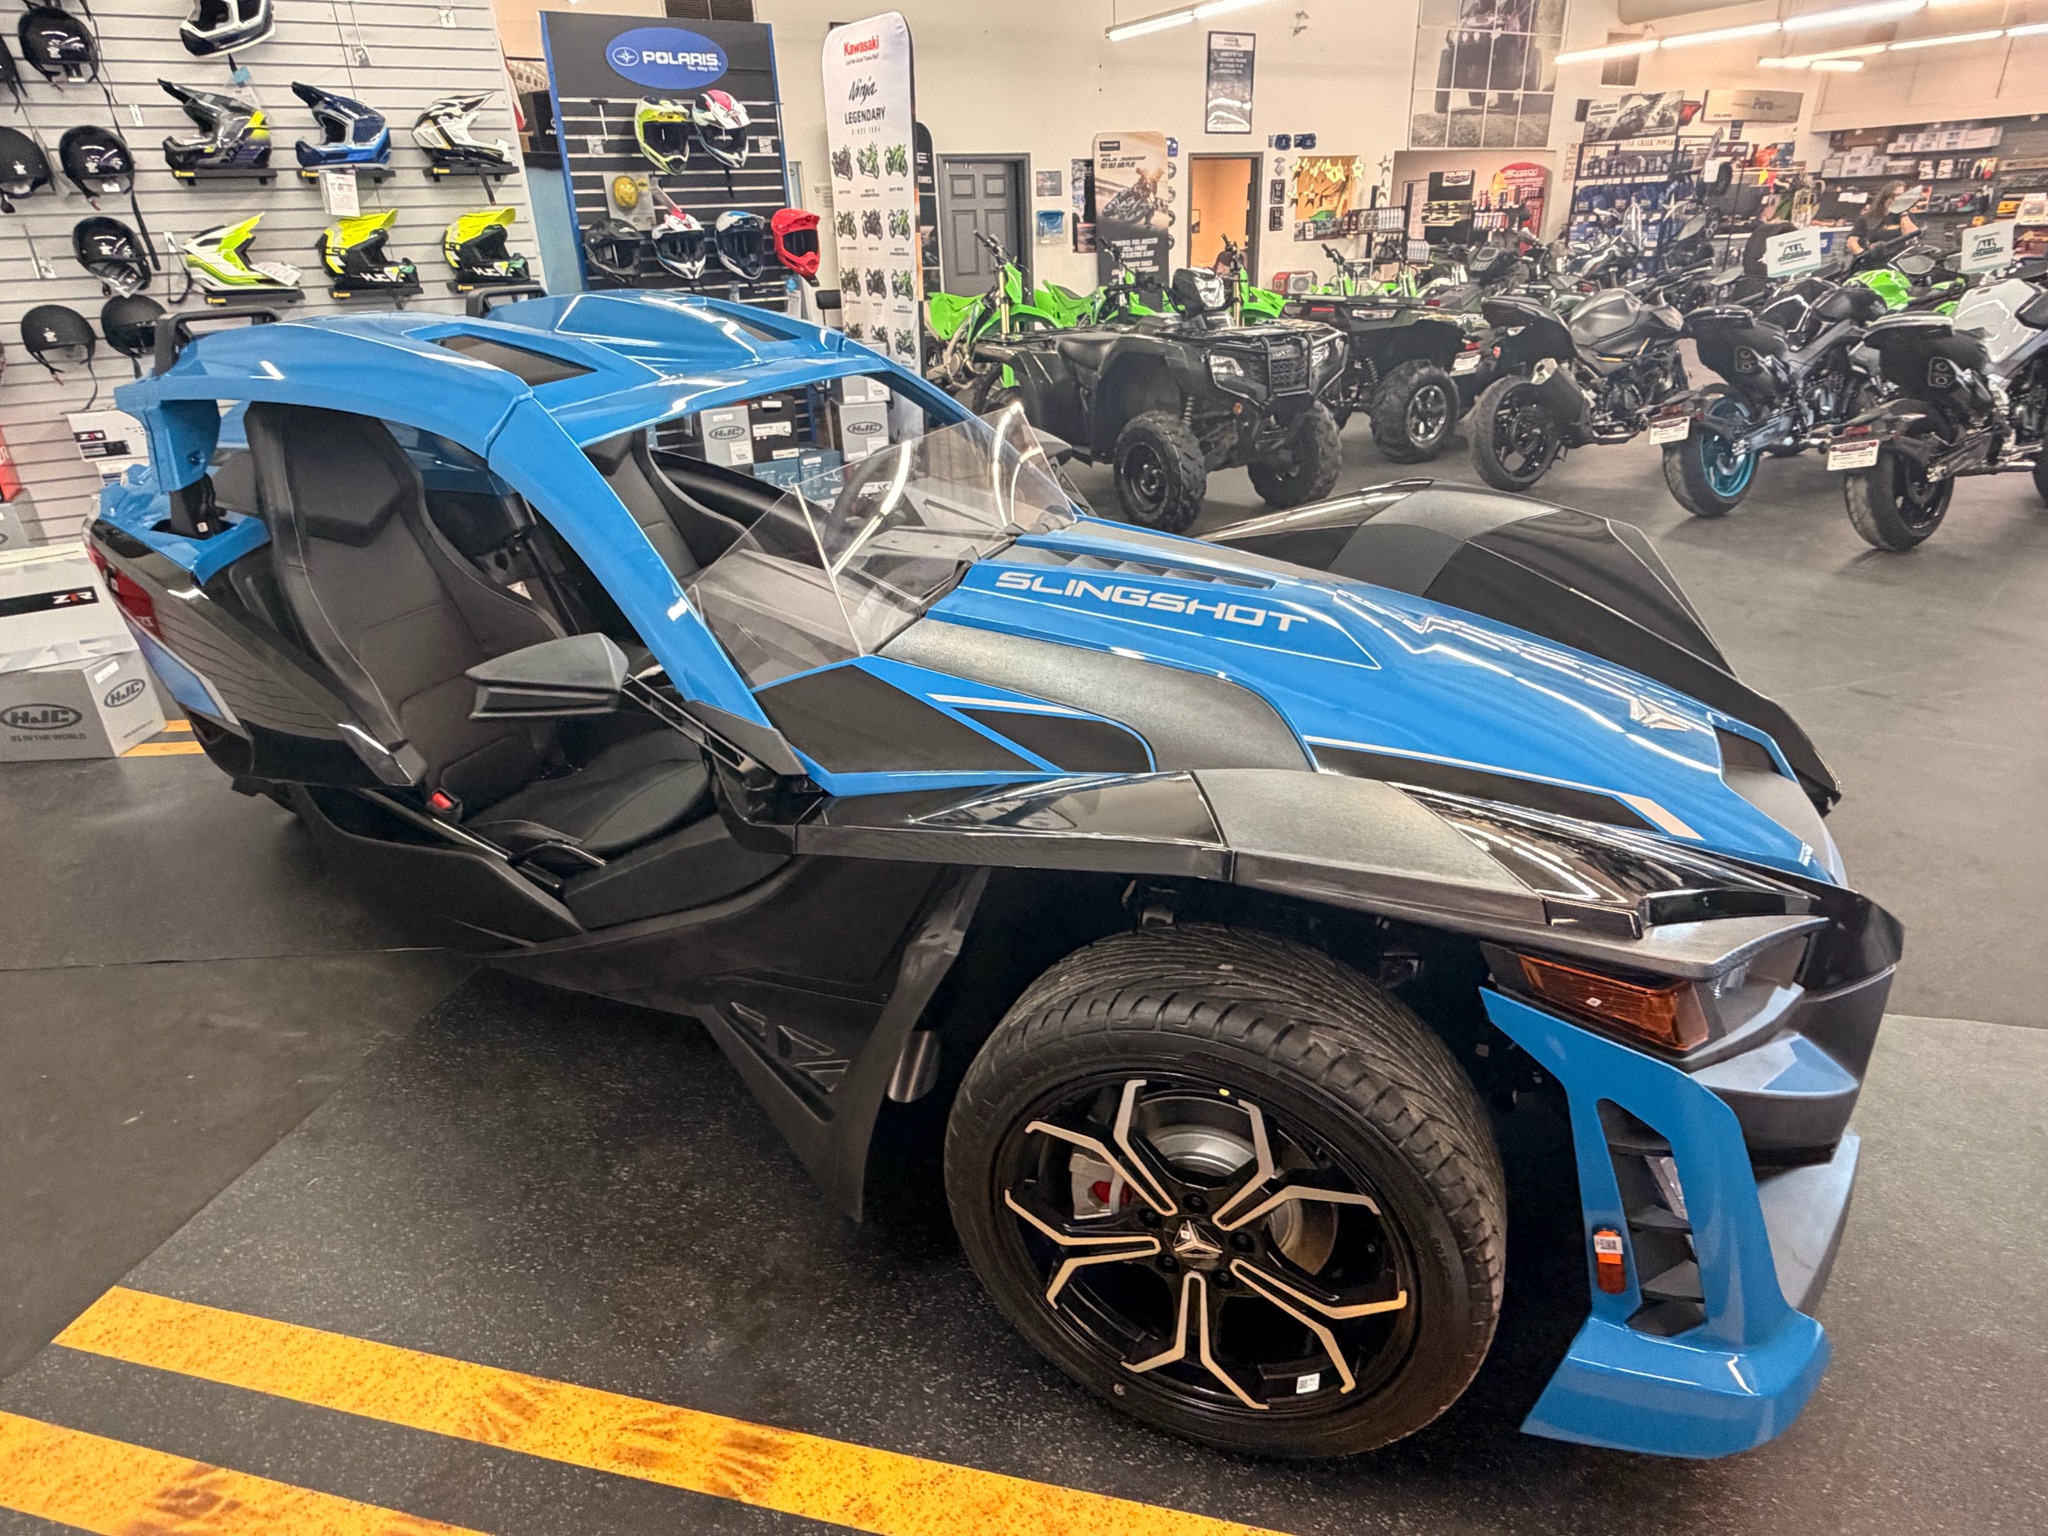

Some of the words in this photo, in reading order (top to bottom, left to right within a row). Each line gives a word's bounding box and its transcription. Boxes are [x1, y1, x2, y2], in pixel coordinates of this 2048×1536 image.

[843, 35, 879, 56] Kawasaki
[642, 51, 720, 66] POLARIS
[848, 76, 877, 105] Ninja
[844, 107, 886, 124] LEGENDARY
[1783, 243, 1804, 256] ALL
[360, 272, 392, 282] HJC
[472, 266, 501, 276] HJC
[714, 429, 740, 437] HJC
[852, 424, 878, 432] HJC
[995, 571, 1309, 632] SLINGSHOT
[110, 682, 140, 705] HJC
[10, 710, 70, 724] HJC
